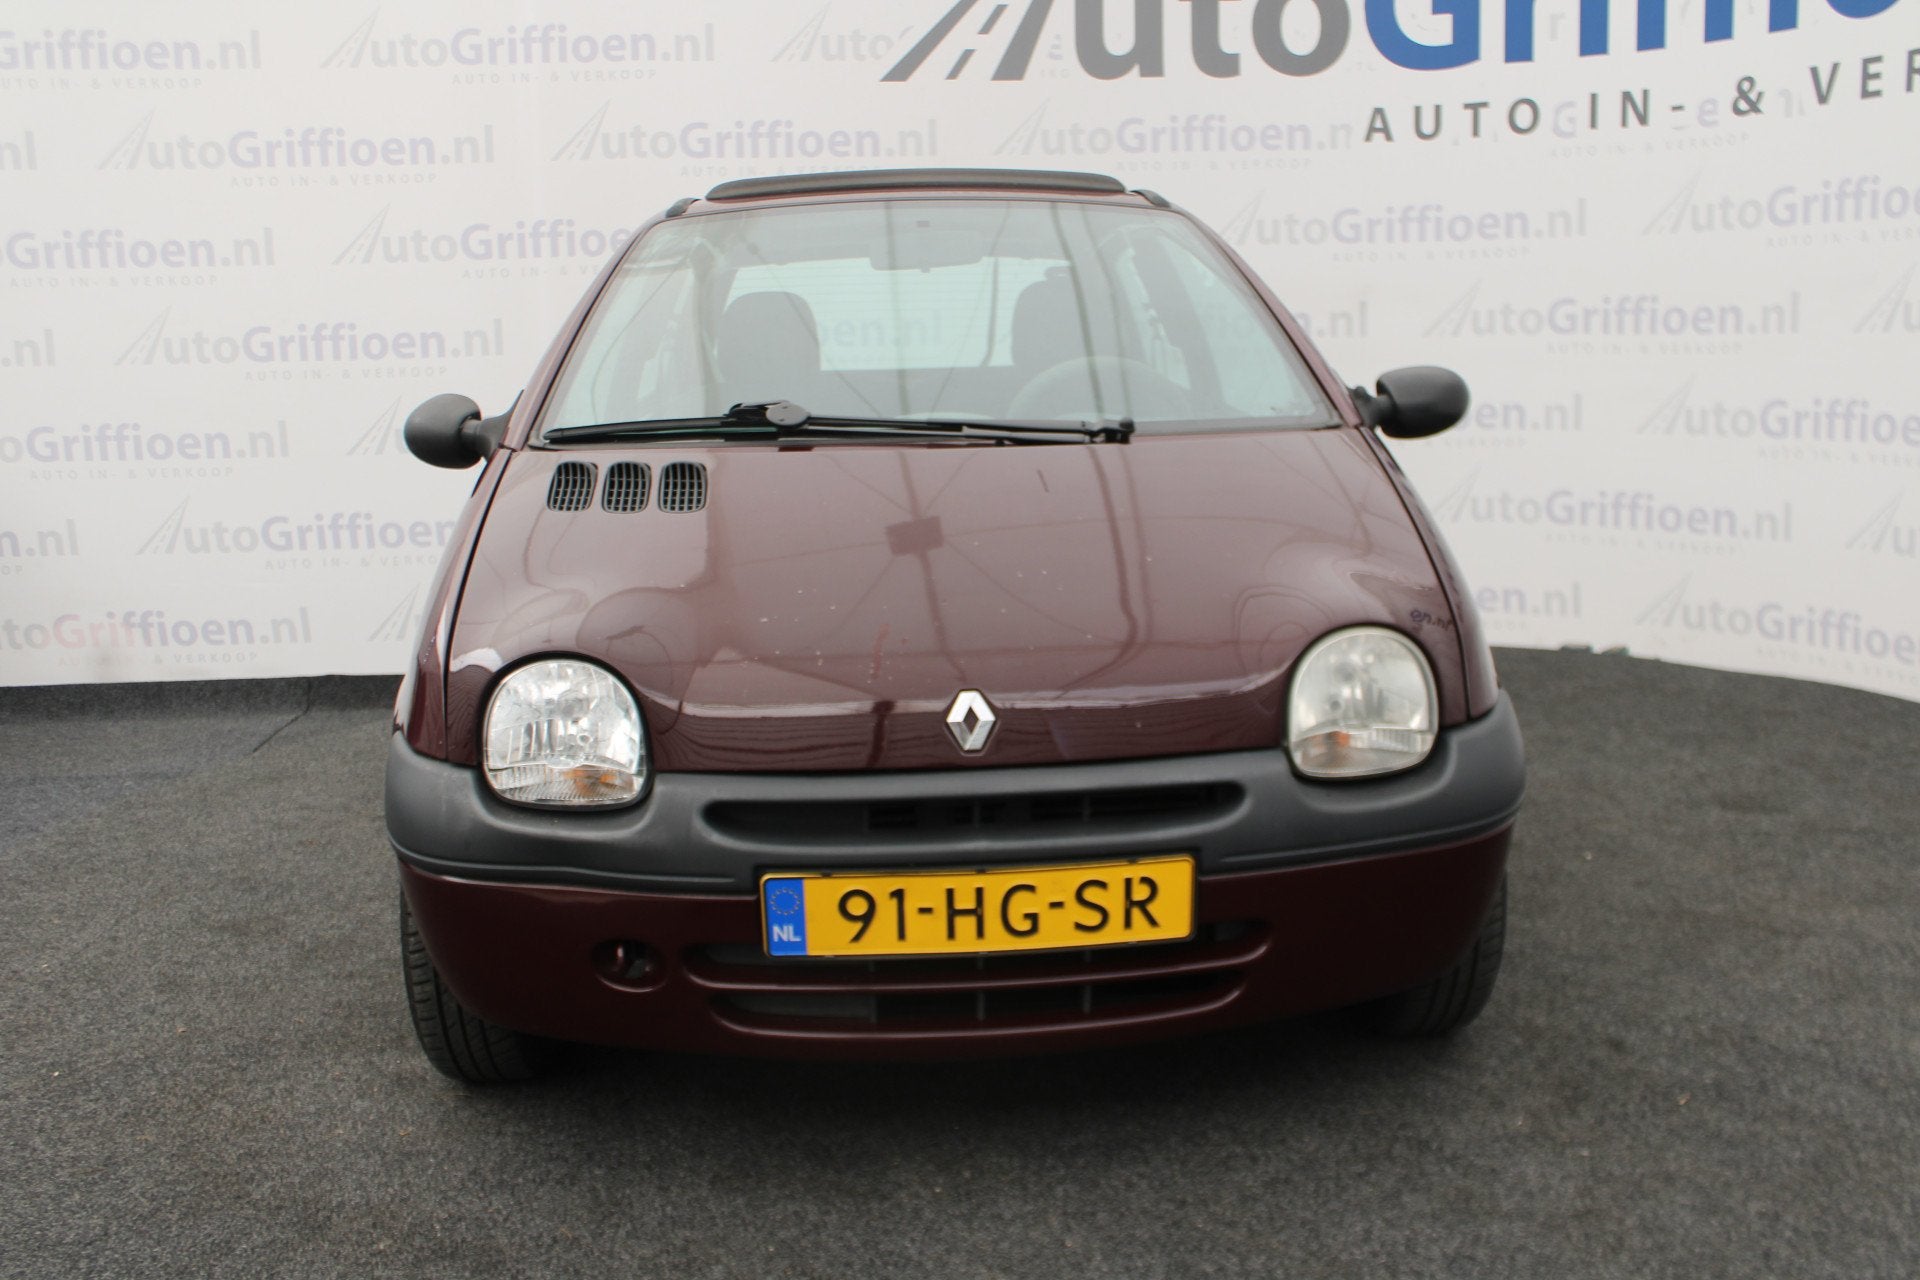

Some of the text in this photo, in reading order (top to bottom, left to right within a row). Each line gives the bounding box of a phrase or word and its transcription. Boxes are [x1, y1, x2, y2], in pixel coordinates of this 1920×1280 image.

[1364, 98, 1540, 142] AUTO
[1731, 77, 1766, 117] &
[0, 226, 275, 270] Griffioen.nl
[772, 924, 801, 942] NL
[837, 876, 1160, 943] 91-HG-SR
